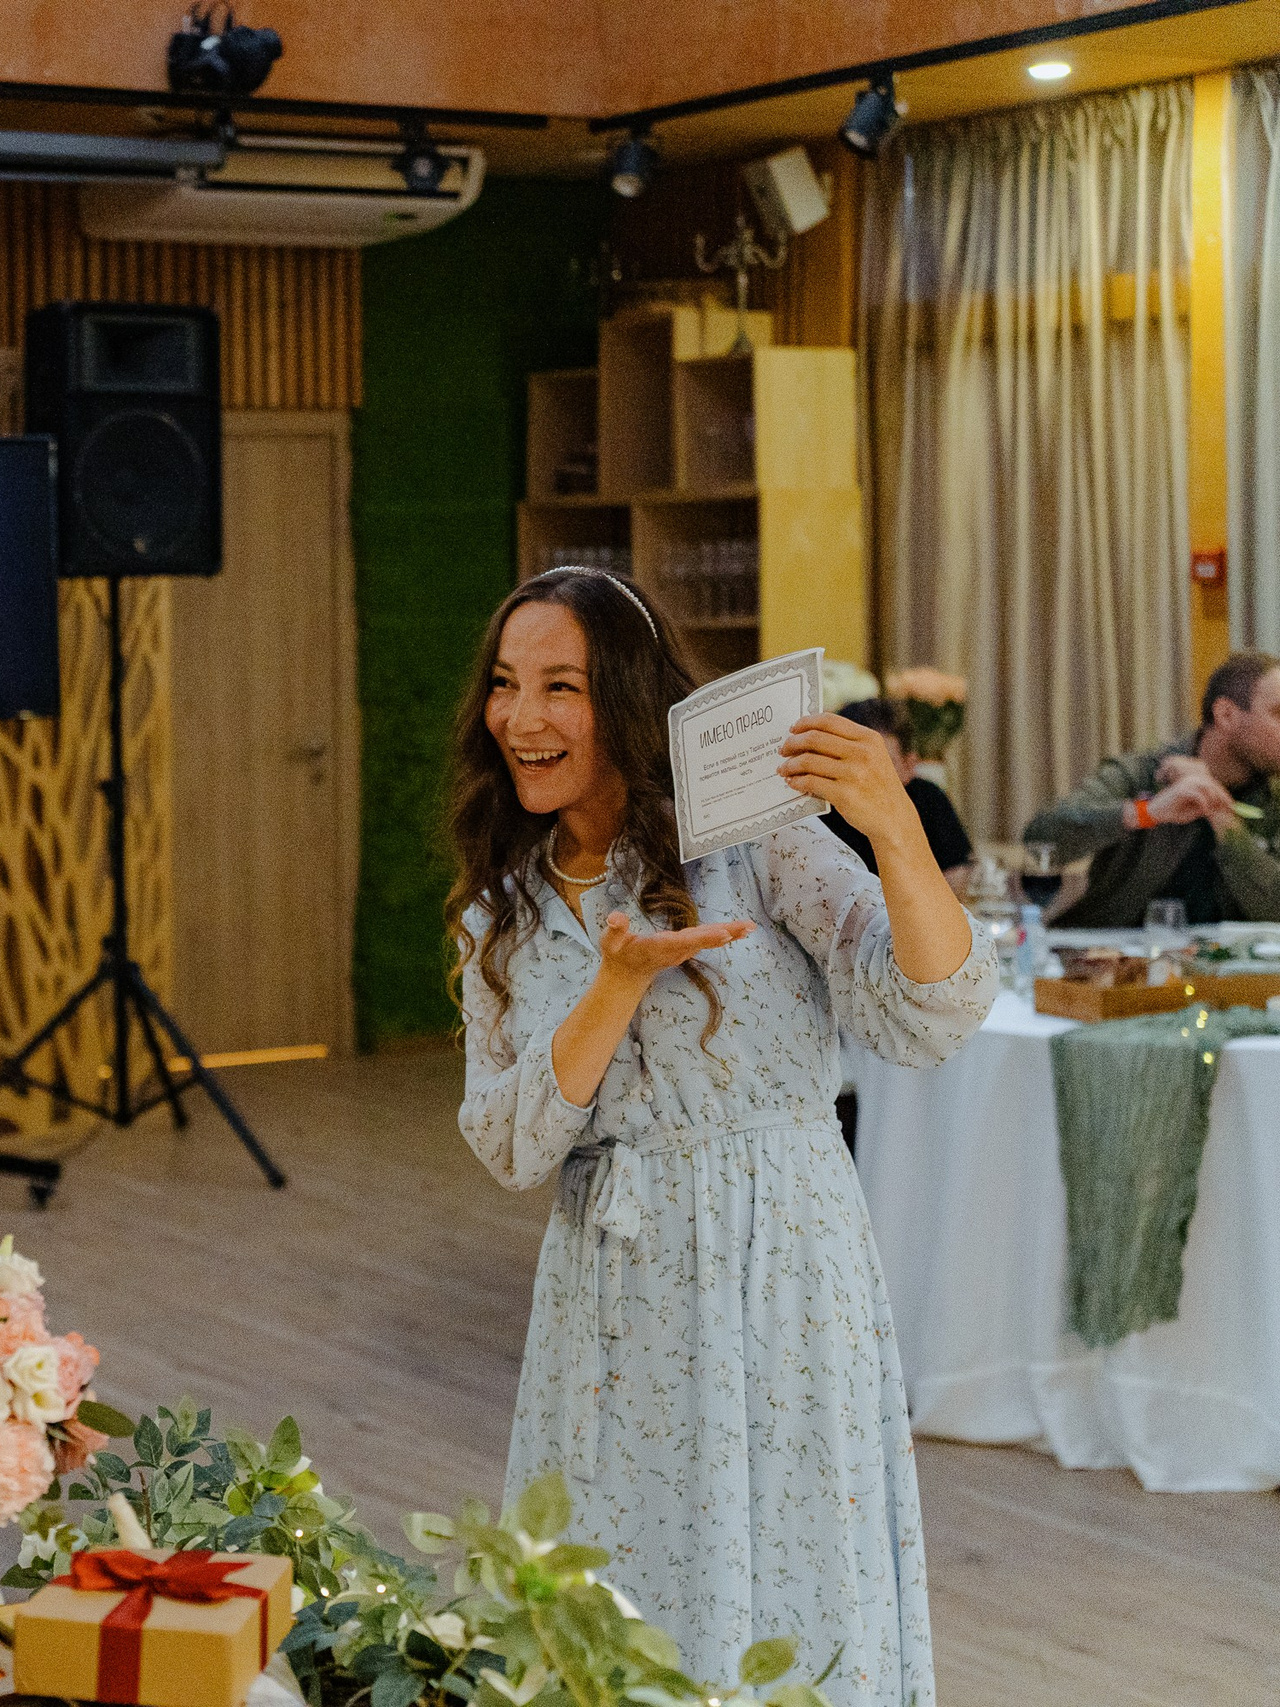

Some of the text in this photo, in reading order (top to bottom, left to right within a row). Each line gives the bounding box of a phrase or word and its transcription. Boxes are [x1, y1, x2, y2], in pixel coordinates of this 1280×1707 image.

[699, 705, 774, 749] ИМЕЮ ПРАВО
[703, 763, 715, 771] Если
